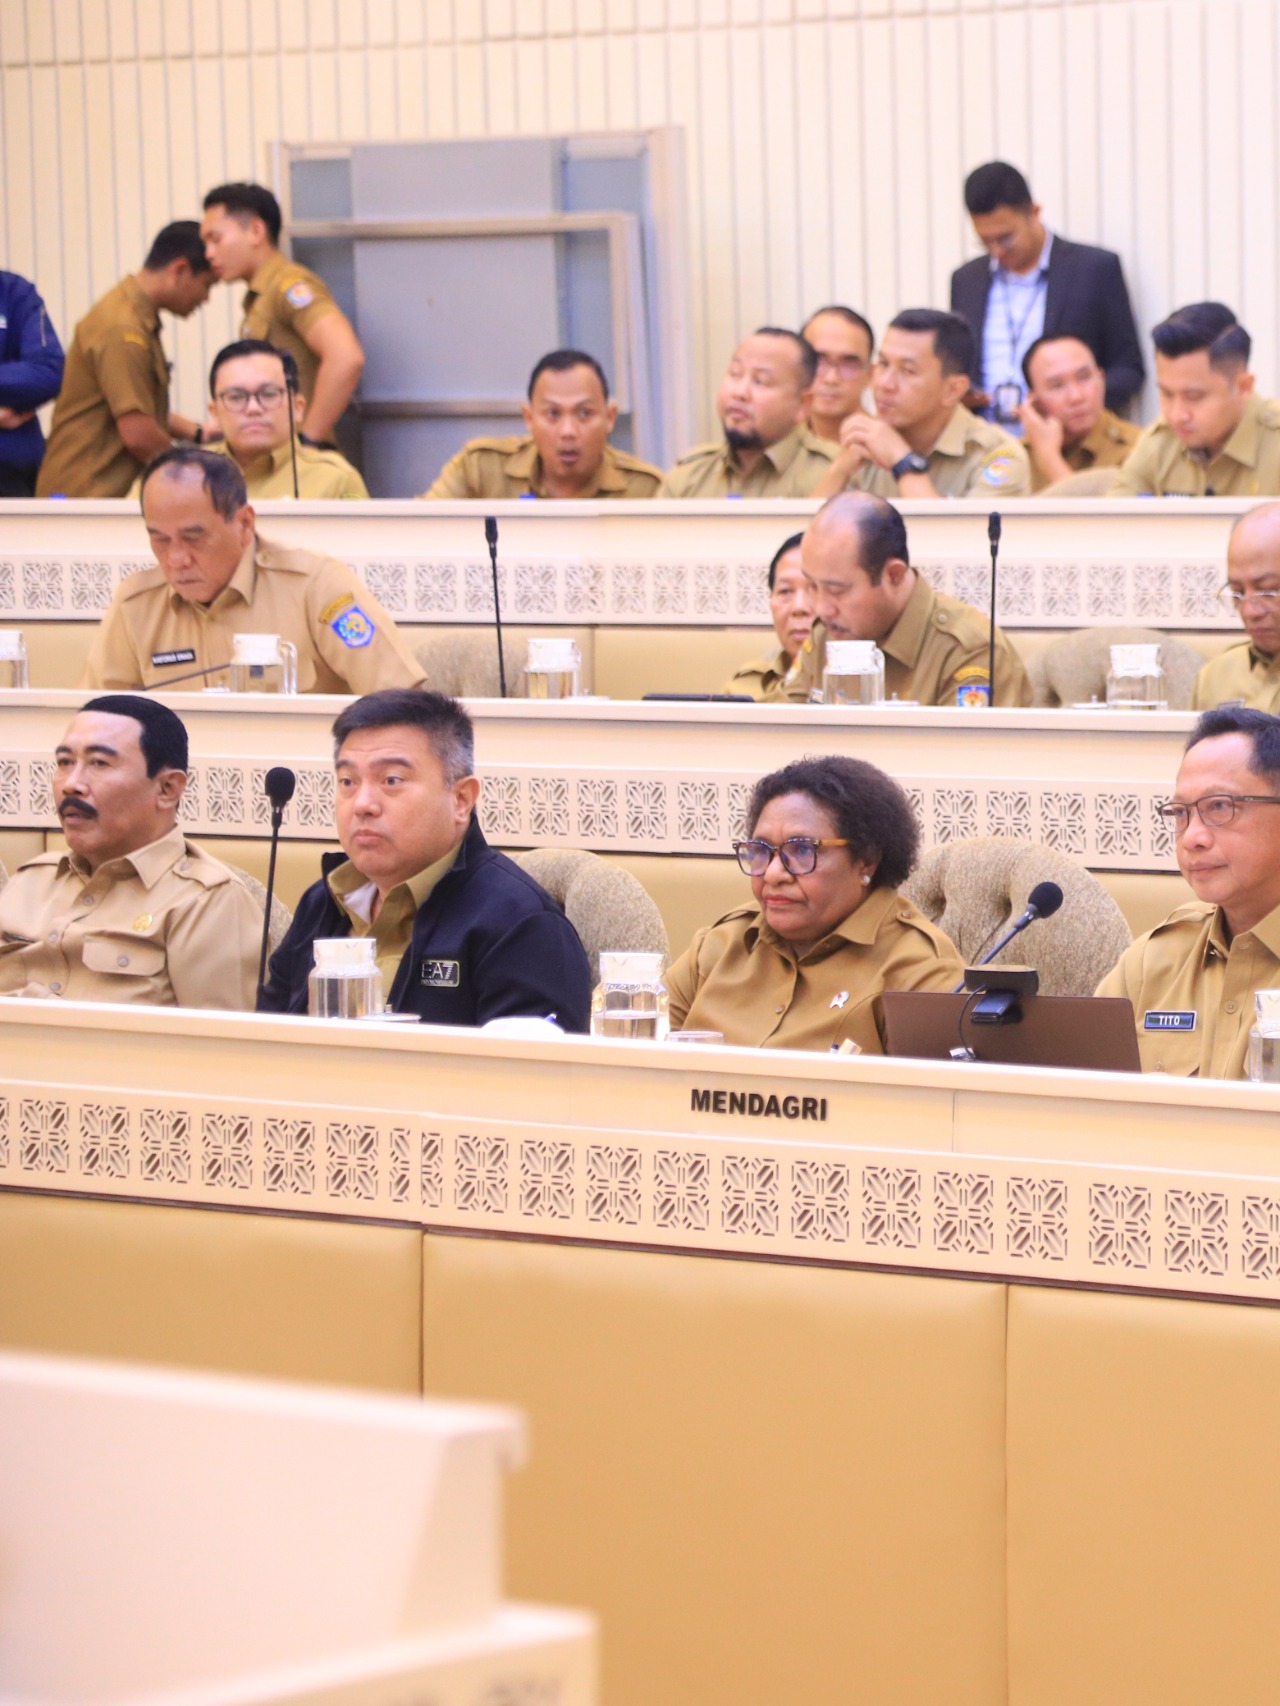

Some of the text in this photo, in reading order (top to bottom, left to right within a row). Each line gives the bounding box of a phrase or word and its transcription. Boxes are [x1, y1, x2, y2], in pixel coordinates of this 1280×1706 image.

[421, 961, 454, 980] EA7
[1159, 1015, 1180, 1026] TITO
[691, 1089, 827, 1121] MENDAGRI
